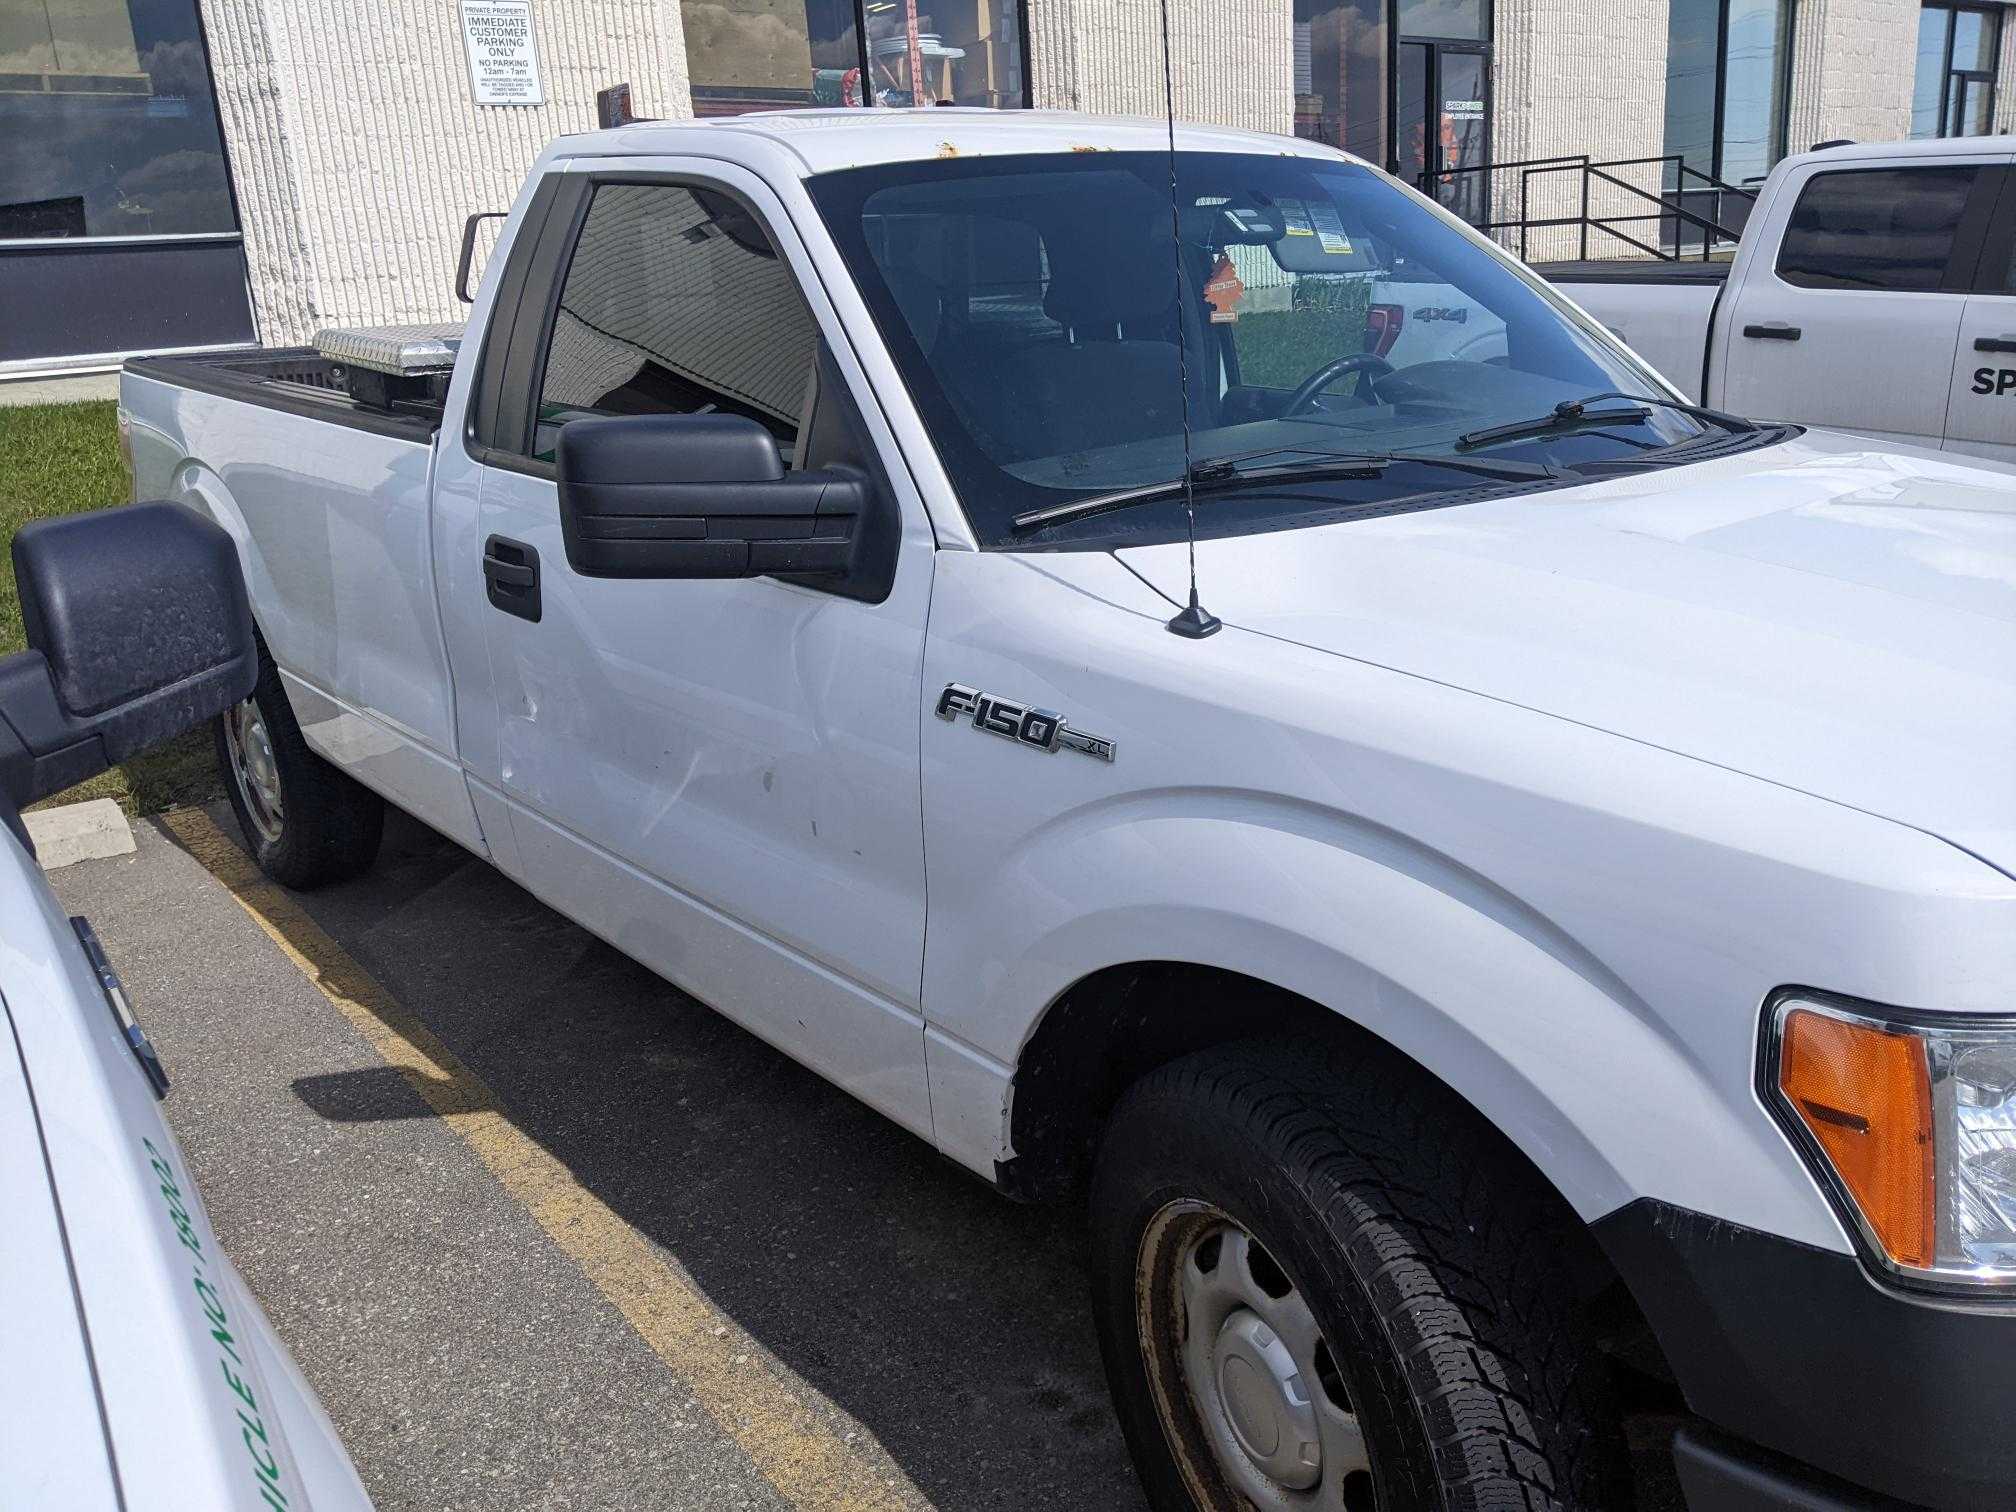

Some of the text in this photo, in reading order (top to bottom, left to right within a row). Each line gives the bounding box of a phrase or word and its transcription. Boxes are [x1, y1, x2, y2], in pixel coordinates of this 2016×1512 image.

[464, 6, 526, 15] PRIVATE PROPERTY
[468, 17, 527, 28] IMMEDIATE
[470, 26, 528, 37] CUSTOMER
[476, 37, 525, 47] PARKING
[488, 47, 515, 57] ONLY
[478, 59, 529, 67] NO PARKING
[484, 67, 504, 75] 12am
[510, 67, 527, 75] 7am
[1971, 367, 2016, 396] SP
